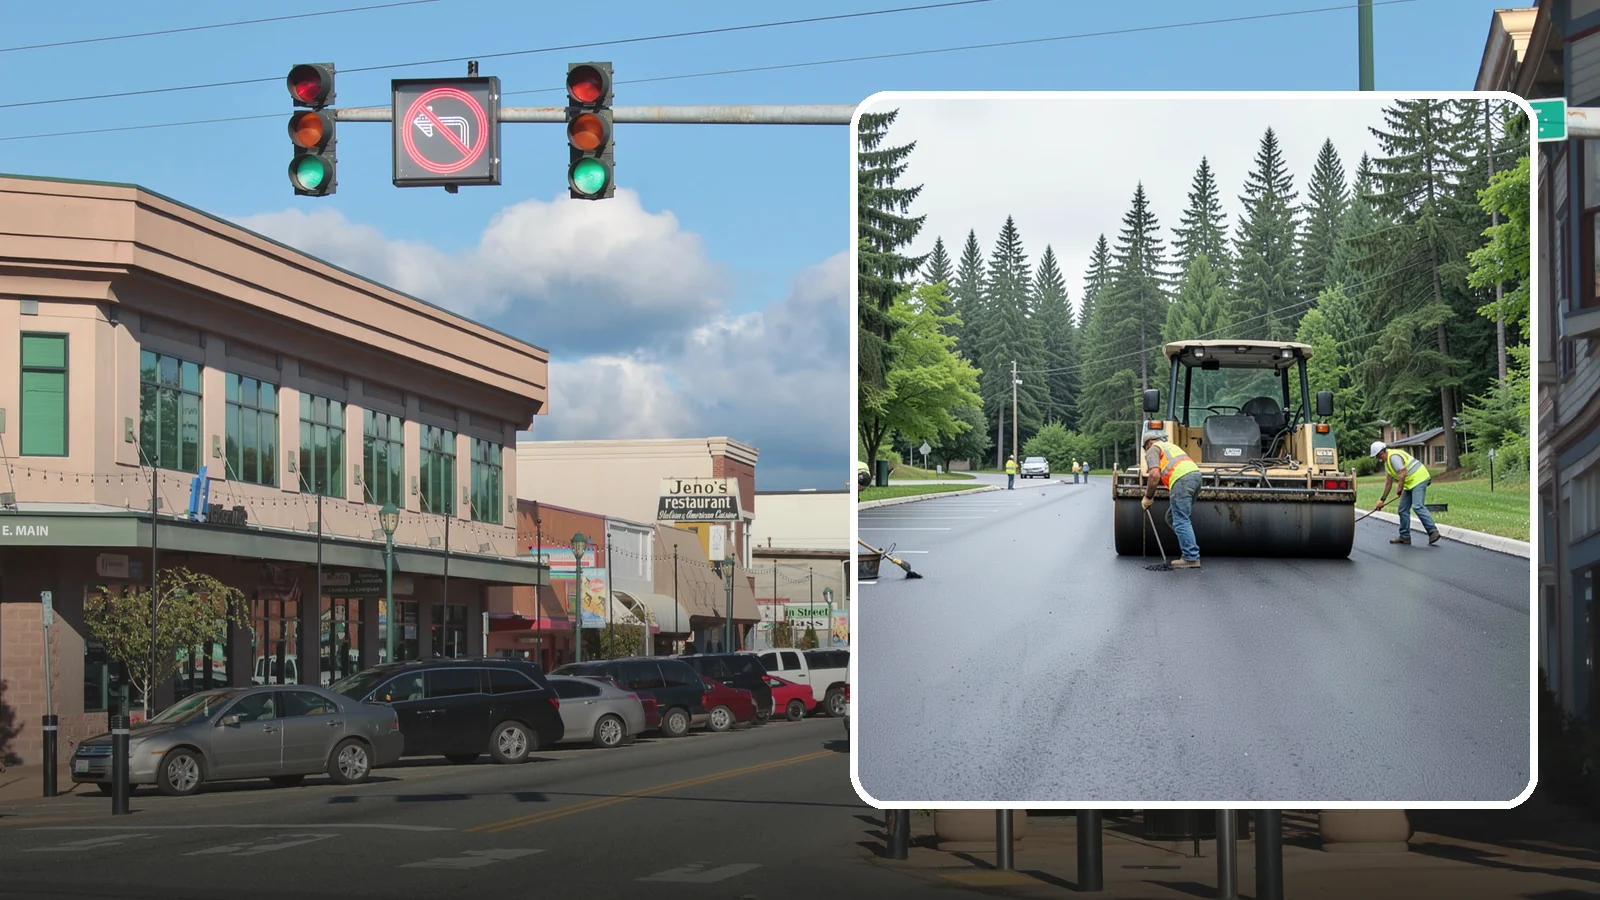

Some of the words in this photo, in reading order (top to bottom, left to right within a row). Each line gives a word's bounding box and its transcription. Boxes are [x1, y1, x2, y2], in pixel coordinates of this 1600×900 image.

[669, 480, 727, 495] Jeno's
[665, 496, 731, 509] restaurant
[658, 509, 681, 519] Italian
[685, 509, 714, 519] American
[715, 509, 738, 519] Cuisine
[2, 525, 13, 536] E.
[15, 525, 49, 536] MAIN
[797, 607, 829, 617] Street
